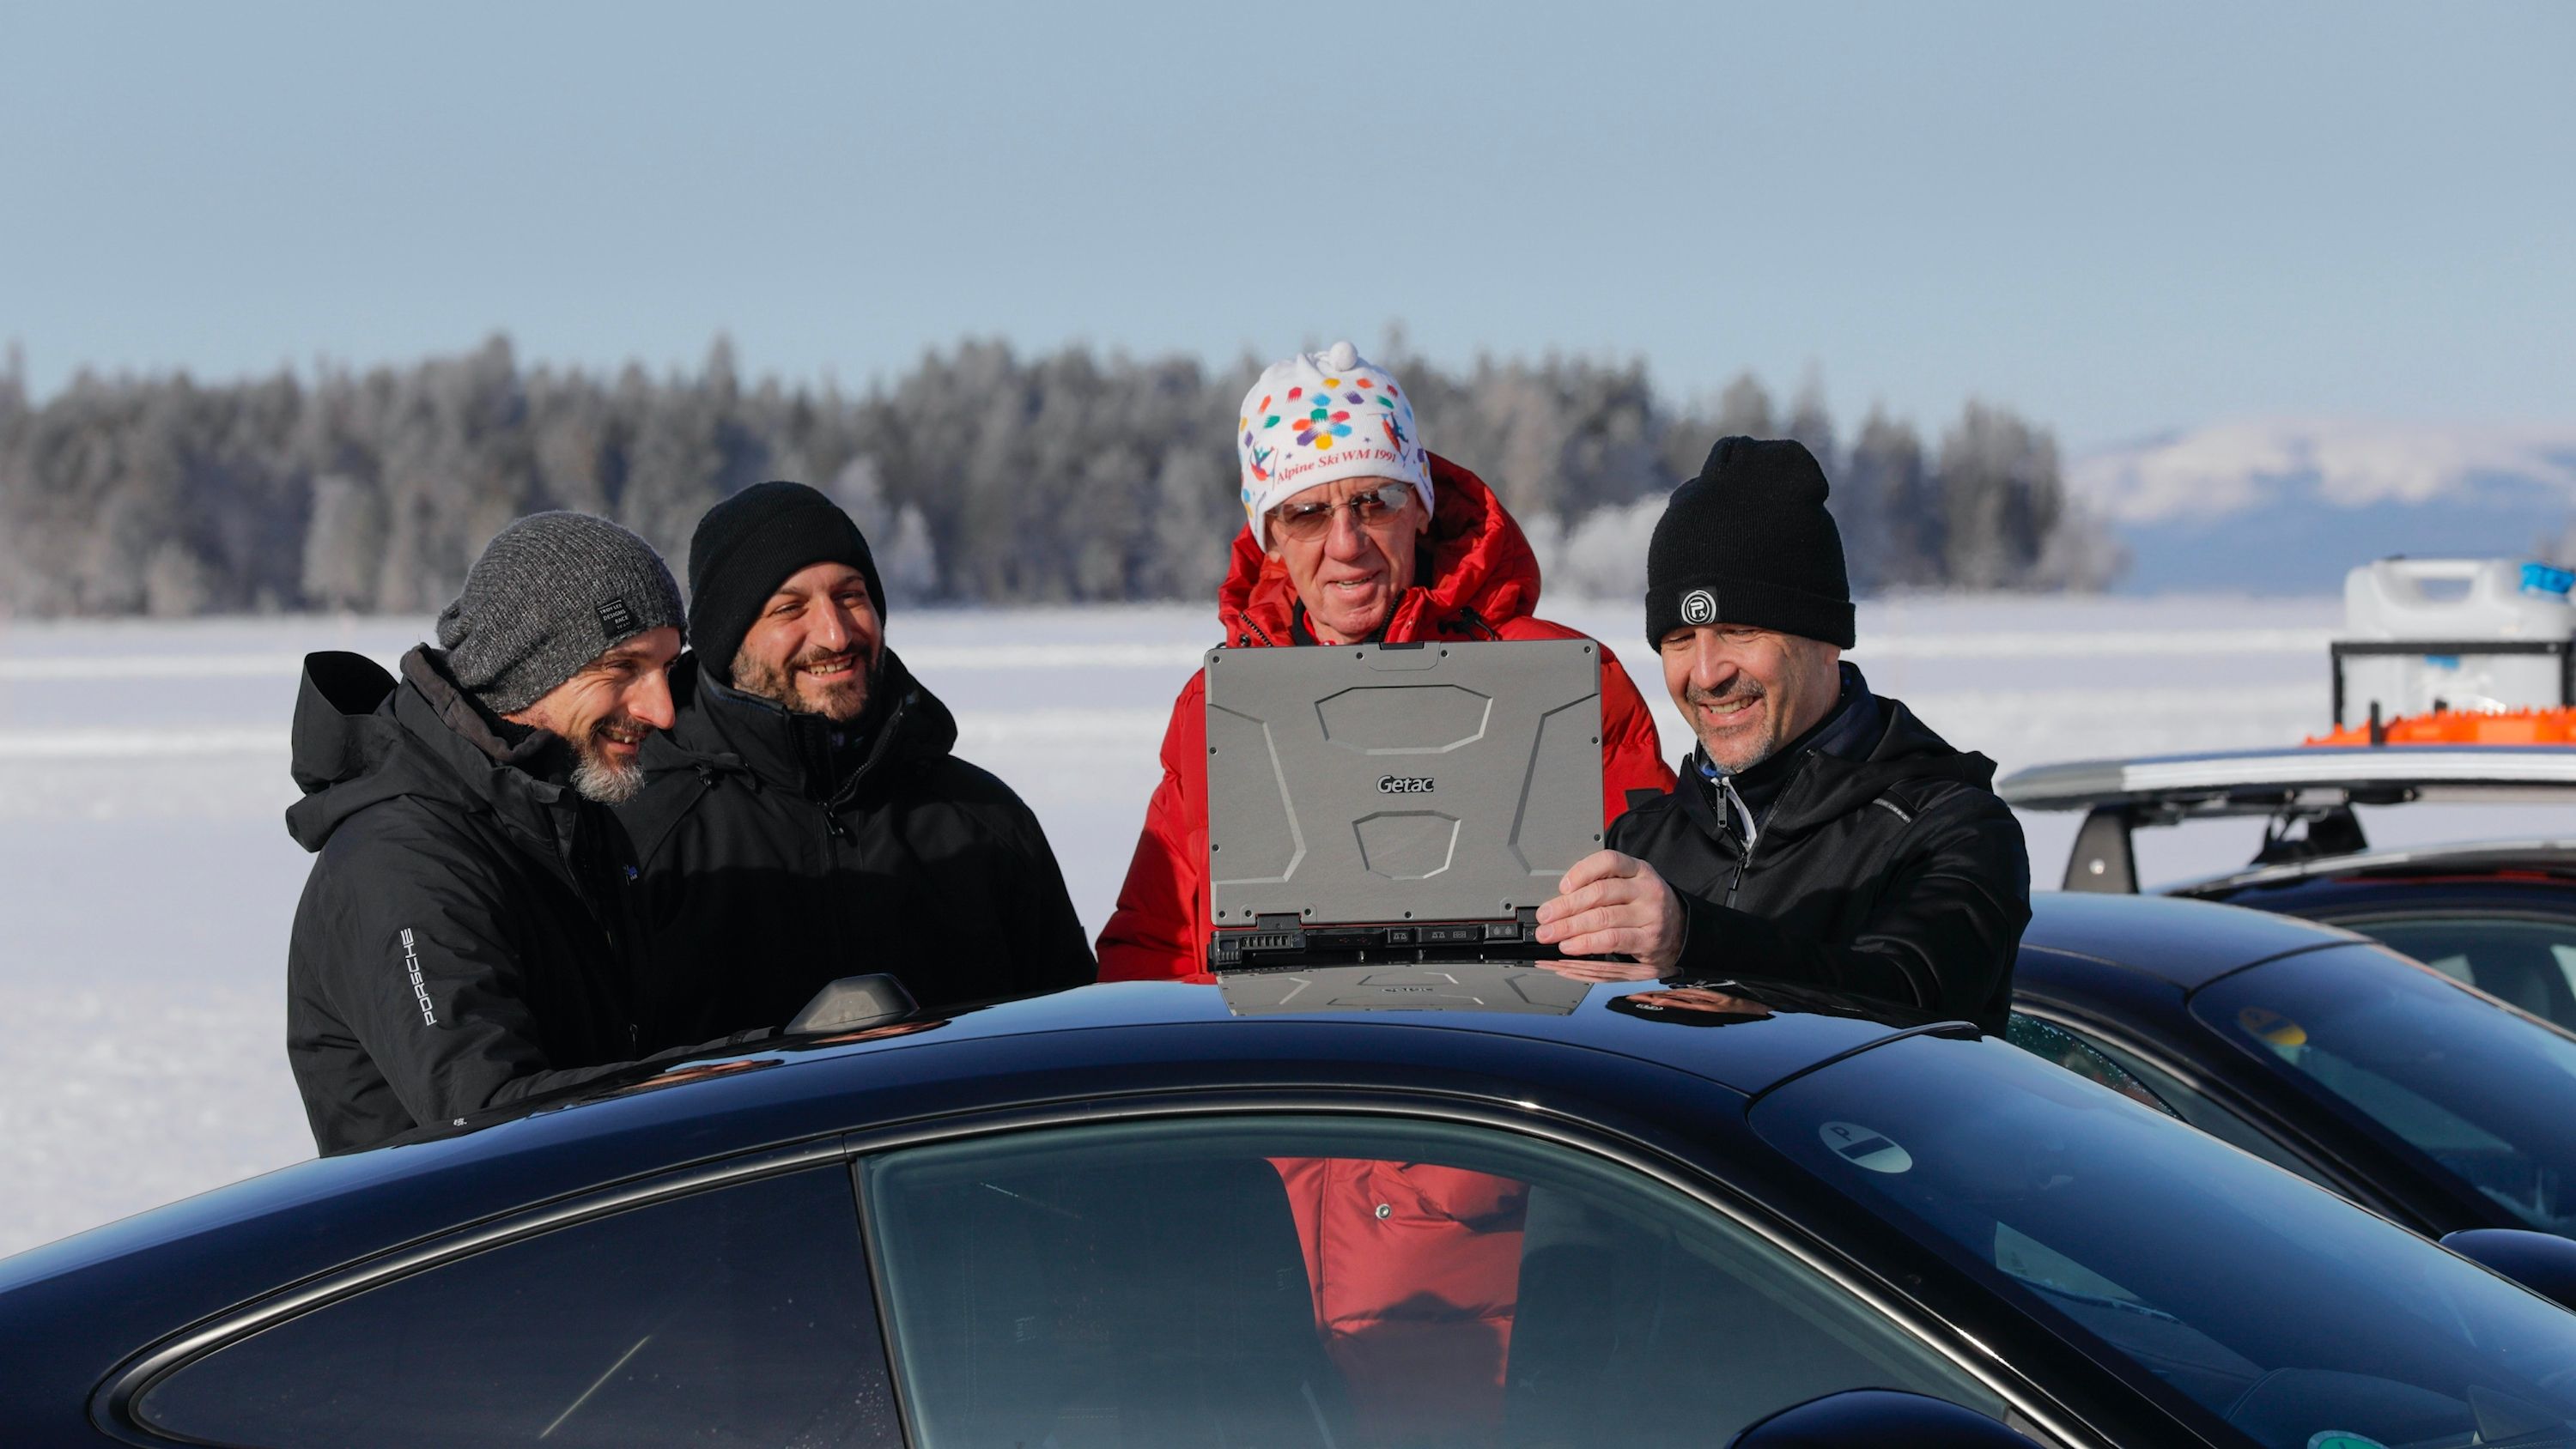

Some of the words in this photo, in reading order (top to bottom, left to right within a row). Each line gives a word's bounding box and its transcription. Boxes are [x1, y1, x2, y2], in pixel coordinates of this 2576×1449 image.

[1277, 462, 1315, 484] Alpine
[1318, 453, 1339, 467] Ski
[1342, 448, 1371, 462] WM
[1374, 449, 1396, 463] 1991
[599, 605, 613, 615] TROY
[603, 609, 626, 621] DESIGNS
[615, 615, 629, 624] RACE
[1376, 775, 1434, 794] Getac
[400, 927, 437, 1026] PORSCHE
